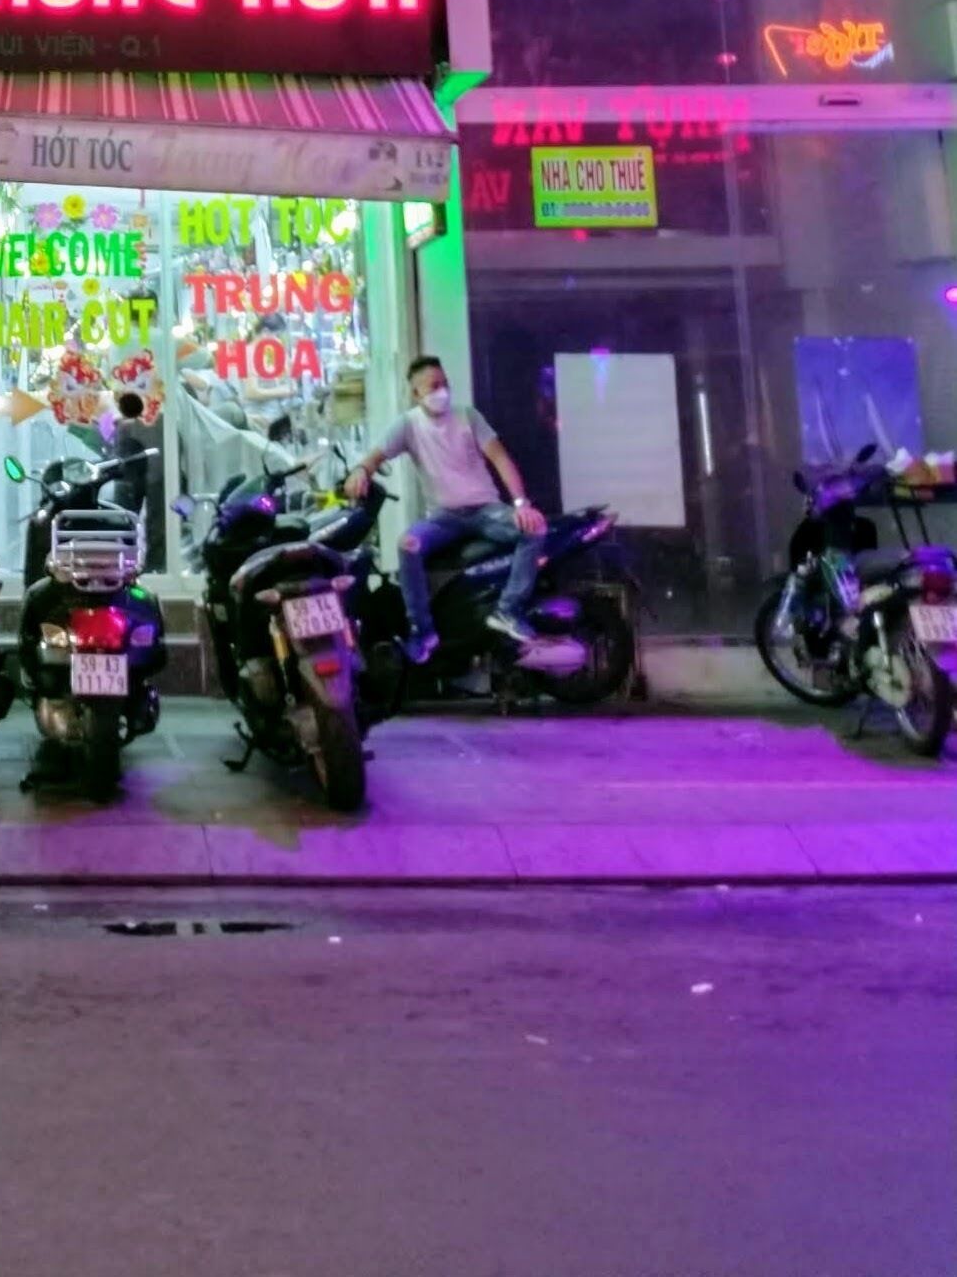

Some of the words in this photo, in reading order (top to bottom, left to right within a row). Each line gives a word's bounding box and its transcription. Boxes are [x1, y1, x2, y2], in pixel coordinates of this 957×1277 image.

[89, 128, 134, 172] TÓC
[576, 159, 605, 191] CHO
[184, 270, 354, 316] TRUNG
[79, 298, 157, 347] CUT
[216, 338, 322, 380] HOA
